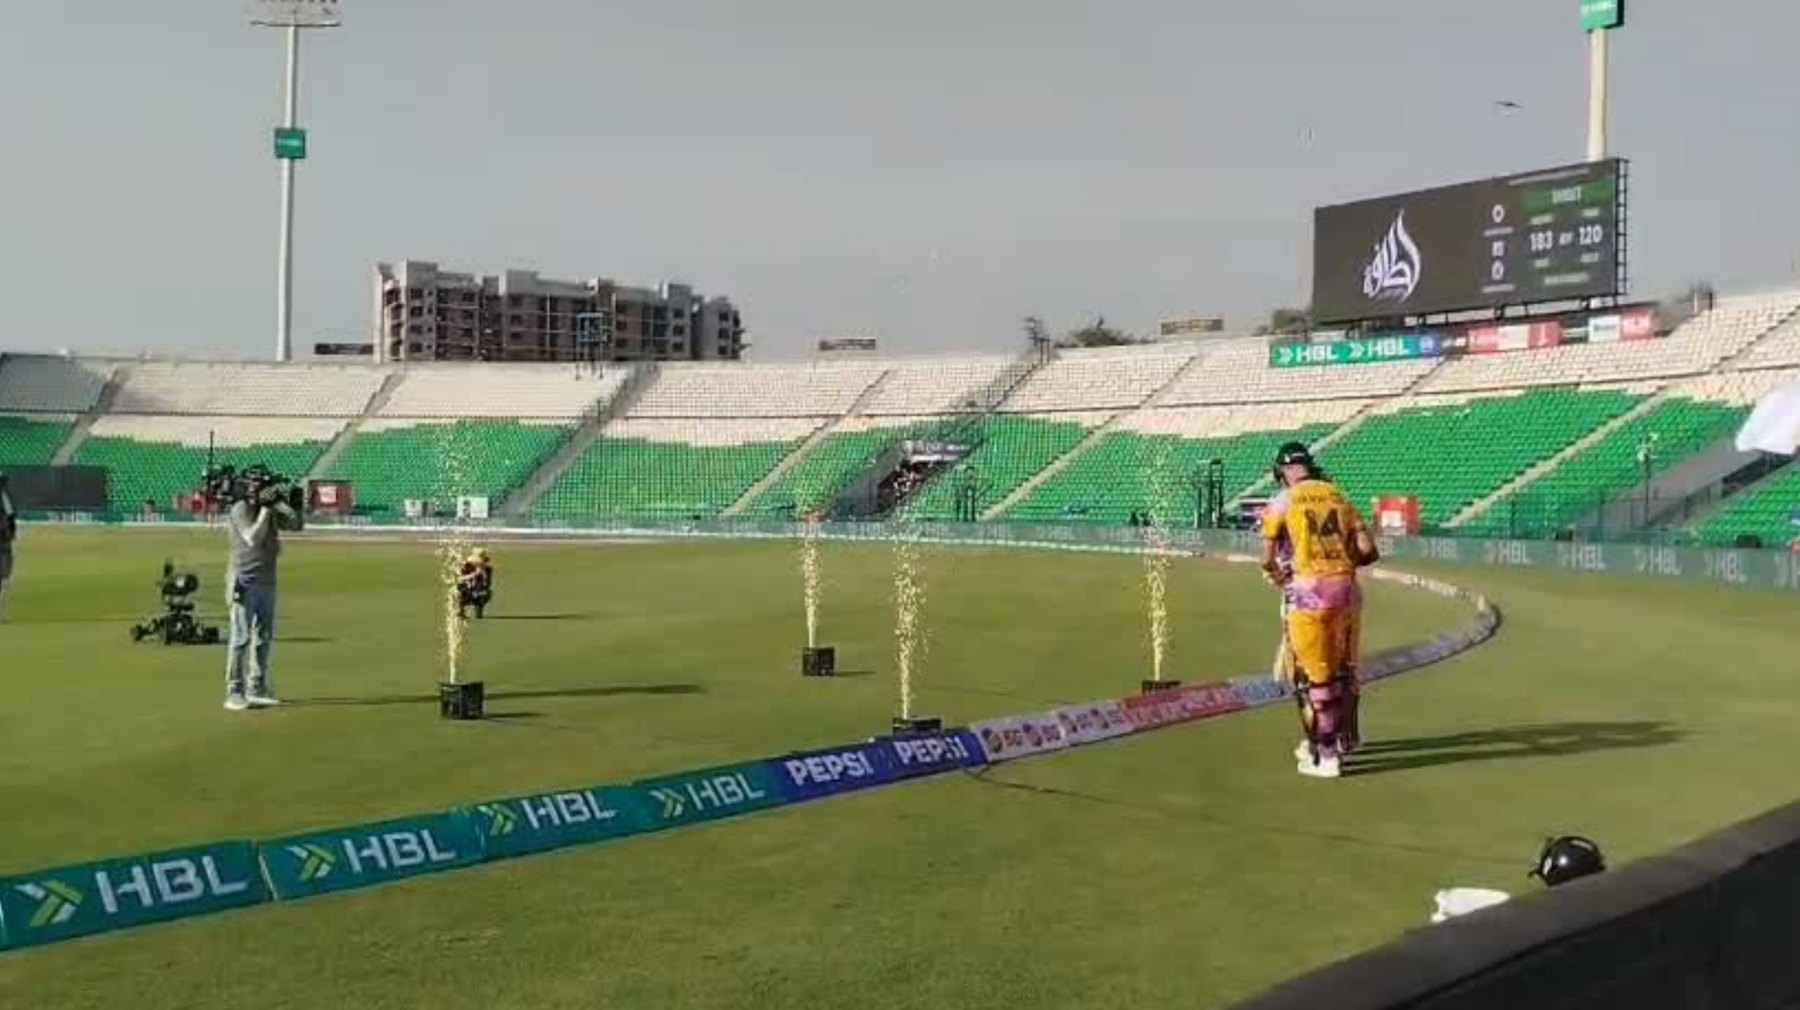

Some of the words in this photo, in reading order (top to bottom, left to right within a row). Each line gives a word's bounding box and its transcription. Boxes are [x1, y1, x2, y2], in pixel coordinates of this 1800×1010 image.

[1579, 224, 1603, 245] 120
[1296, 344, 1338, 362] HBL
[1368, 336, 1410, 357] HBL
[1498, 539, 1532, 565] HBL
[1650, 546, 1683, 576] HBL
[784, 751, 874, 787] PEPSI
[95, 855, 249, 914] HBL
[342, 829, 456, 875] HBL
[522, 790, 619, 829] HBL
[685, 772, 766, 811] HBL
